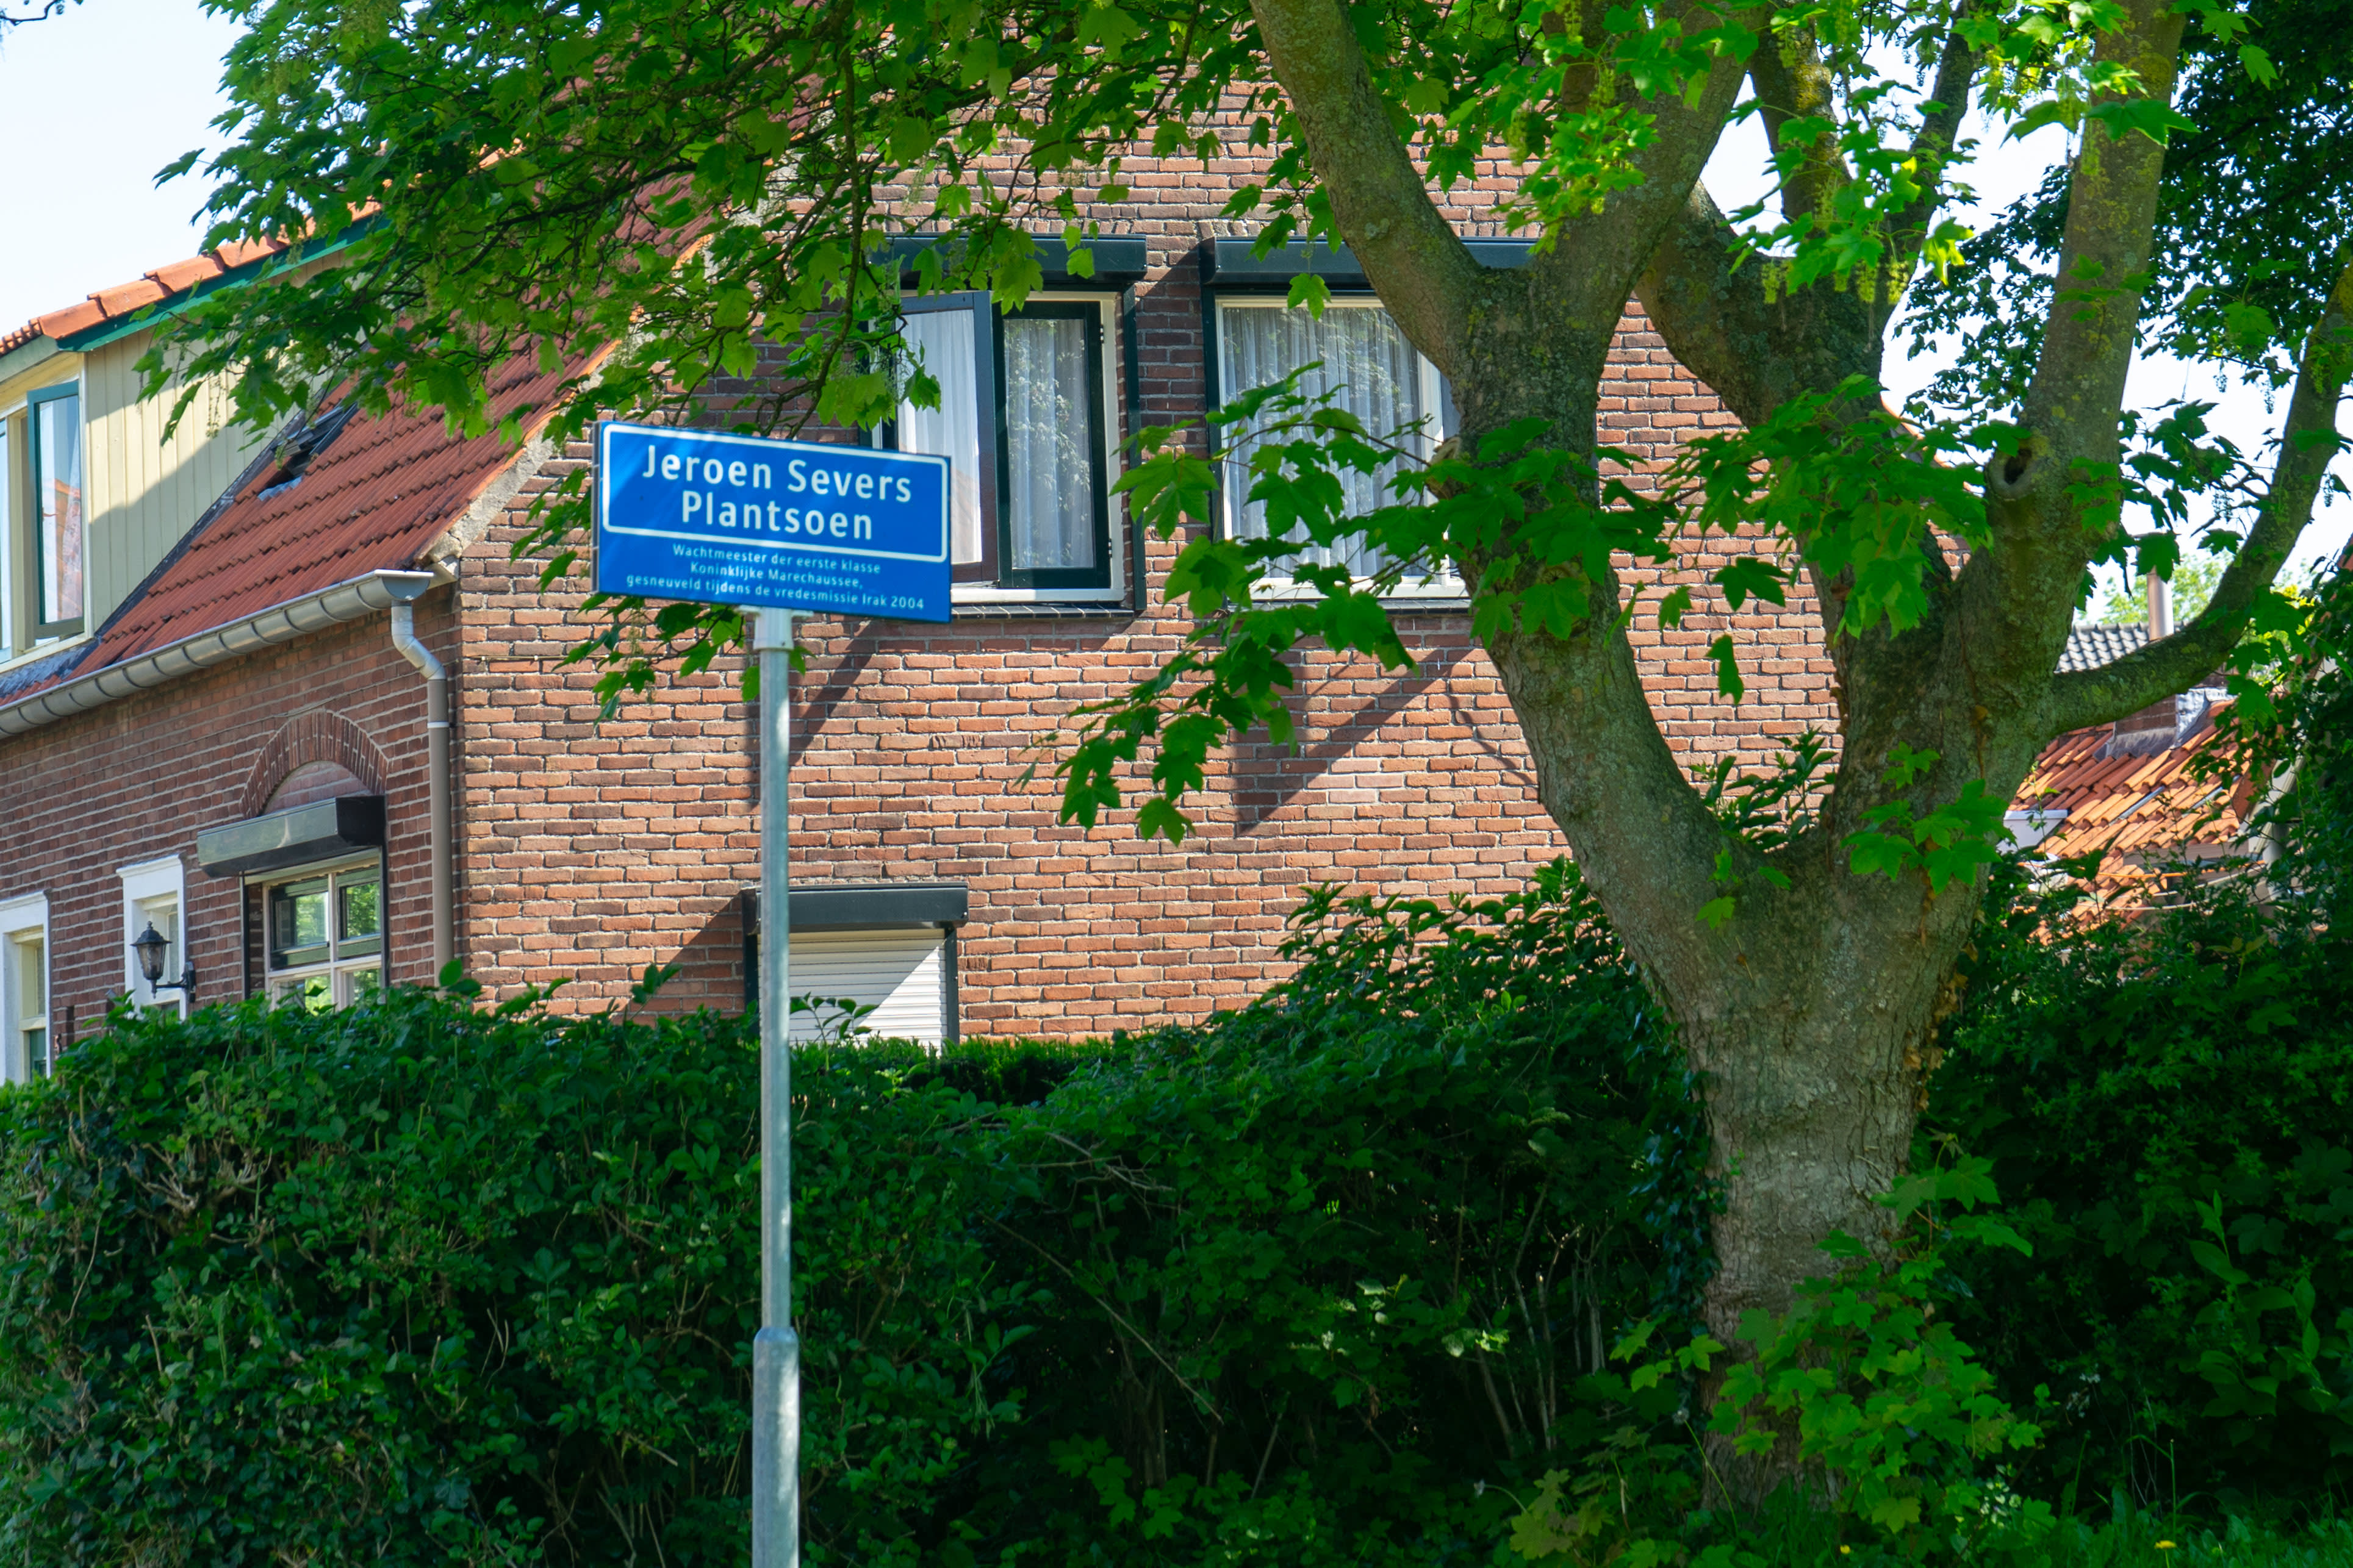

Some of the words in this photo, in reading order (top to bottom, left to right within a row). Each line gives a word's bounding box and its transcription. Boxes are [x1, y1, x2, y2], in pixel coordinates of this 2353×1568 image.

[642, 445, 772, 490] Jeroen
[787, 459, 912, 503] Severs
[681, 490, 872, 540] Plantsoen
[672, 543, 767, 563] Wachtmeester
[771, 553, 792, 565] der
[796, 556, 837, 570] eerste
[841, 559, 880, 574] klasse
[690, 561, 763, 581] Koninklijke
[768, 568, 863, 590] Marechaussee,
[627, 574, 701, 590] gesneuveld
[705, 580, 750, 595] tijdens
[755, 584, 770, 596] de
[774, 587, 858, 604] vredesmissie
[862, 593, 887, 606] Irak
[891, 595, 924, 609] 2004
